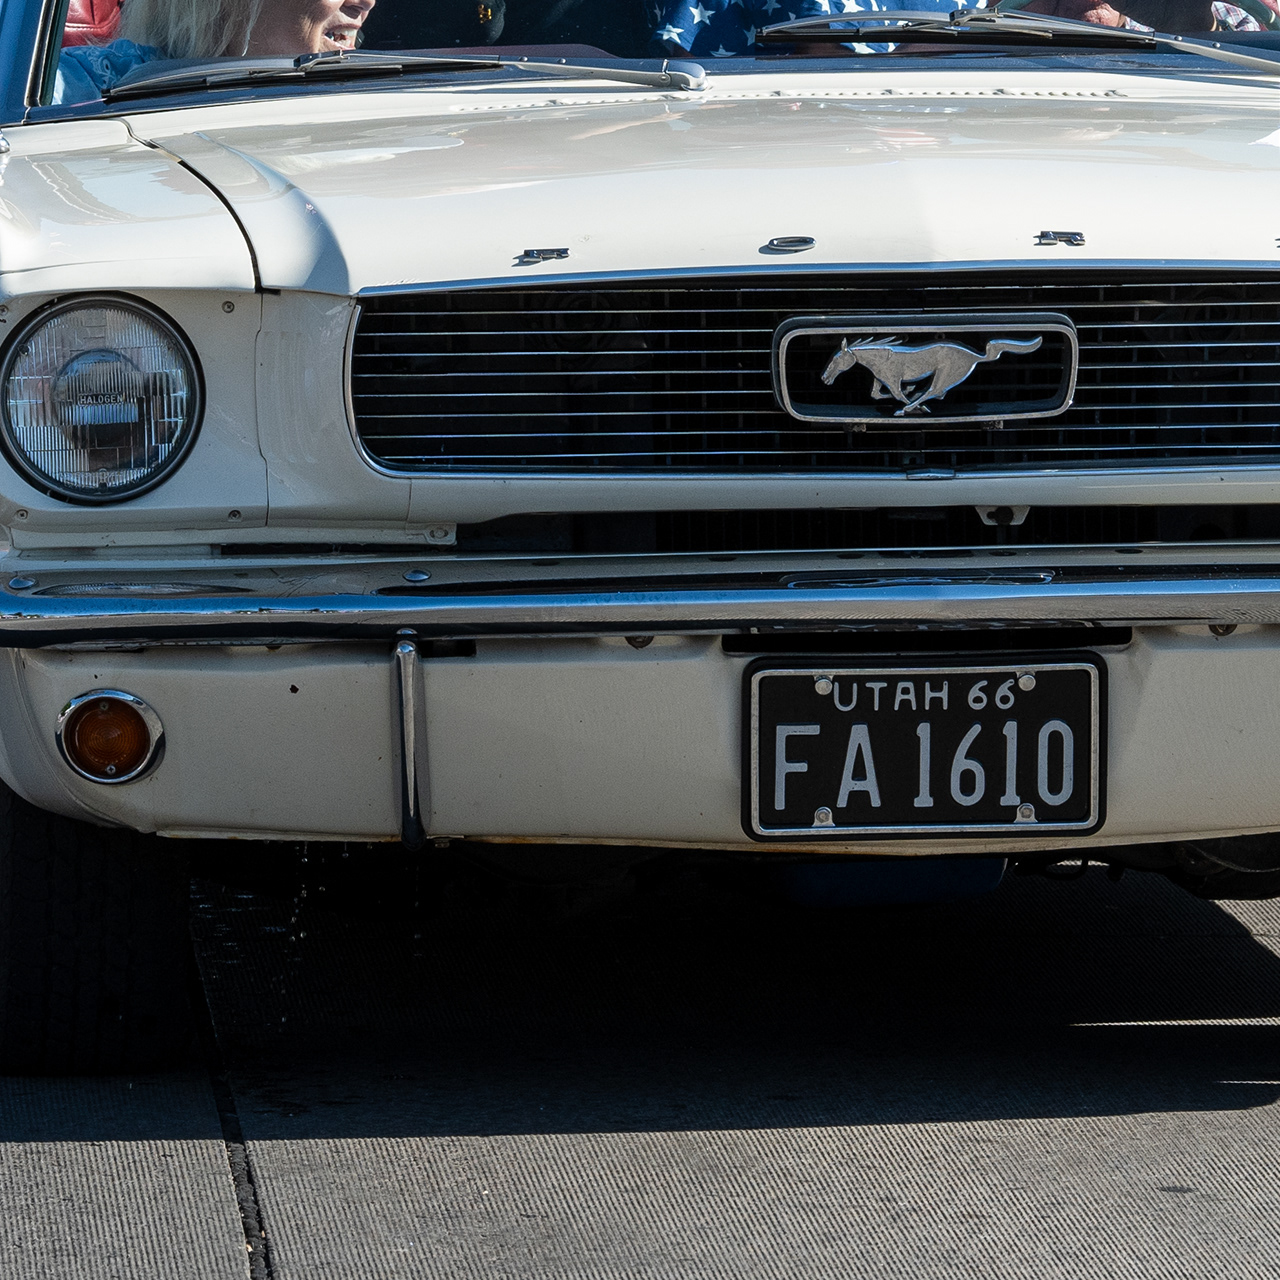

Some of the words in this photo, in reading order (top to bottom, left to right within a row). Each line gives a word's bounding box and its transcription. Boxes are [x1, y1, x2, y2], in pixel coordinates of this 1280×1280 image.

[79, 394, 123, 404] HALOGEN
[833, 680, 949, 712] UTAH
[966, 678, 1015, 711] 66
[774, 721, 881, 811] FA
[913, 719, 1074, 808] 1610
